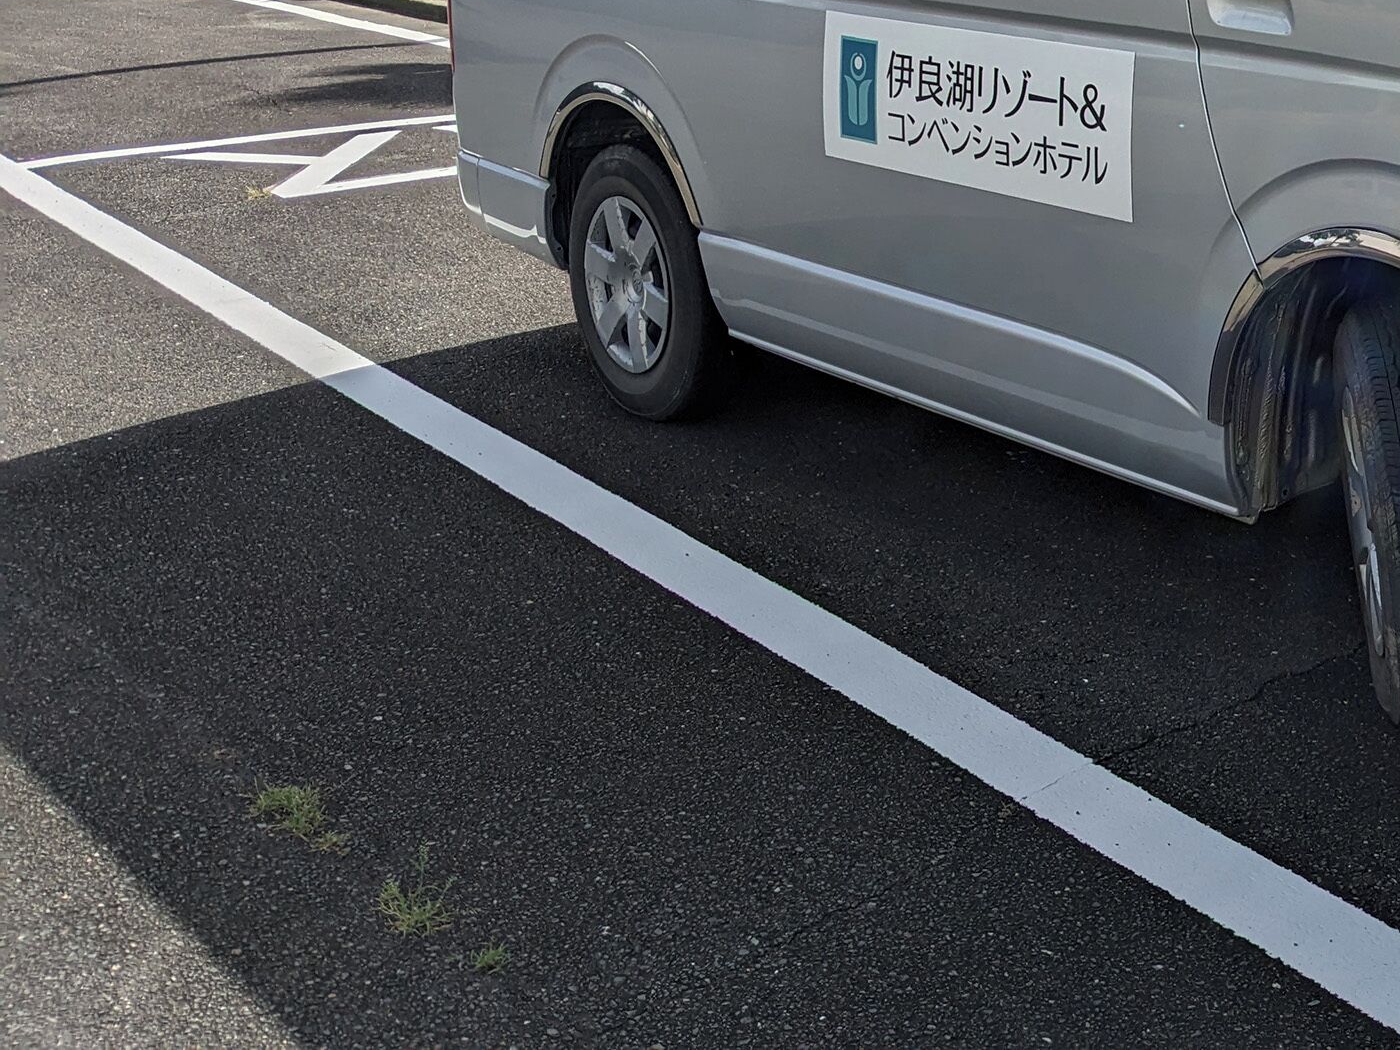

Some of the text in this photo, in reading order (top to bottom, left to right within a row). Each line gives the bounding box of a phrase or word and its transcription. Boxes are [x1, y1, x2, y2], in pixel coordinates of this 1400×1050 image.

[886, 111, 1108, 185] コンベンションホテル
